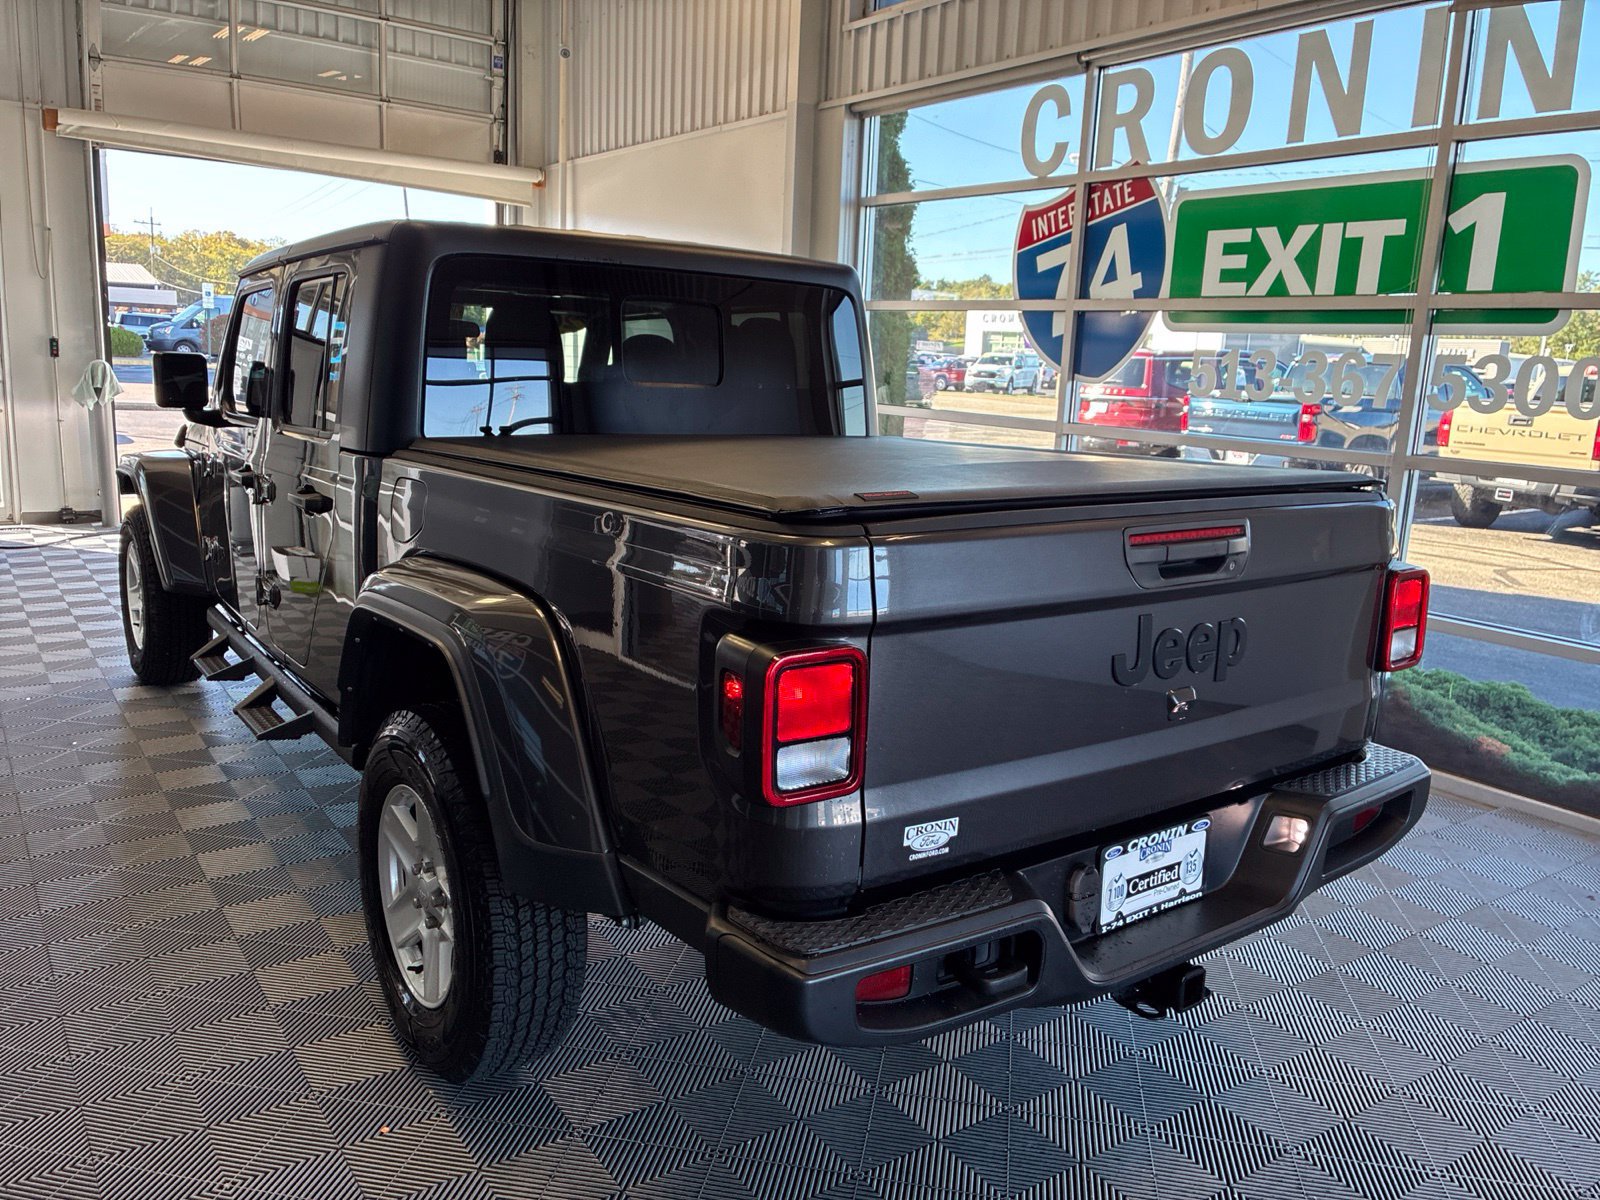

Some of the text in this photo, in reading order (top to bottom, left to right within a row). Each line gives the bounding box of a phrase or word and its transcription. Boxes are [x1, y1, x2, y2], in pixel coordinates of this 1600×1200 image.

[1021, 1, 1585, 178] CRONIN
[1031, 180, 1136, 241] INTERTATE
[1201, 192, 1507, 296] EXIT 1
[1036, 222, 1143, 337] 74
[1456, 424, 1588, 442] CHEVROLET
[1111, 613, 1248, 687] Jeep
[906, 819, 957, 841] CRONIN
[919, 834, 942, 848] Ford
[1127, 823, 1189, 853] CRONIN
[1140, 840, 1173, 861] CRONIN
[1128, 865, 1179, 894] Certified
[1185, 859, 1198, 875] 135
[1102, 892, 1203, 934] I-74 EXIT 1 Harrison
